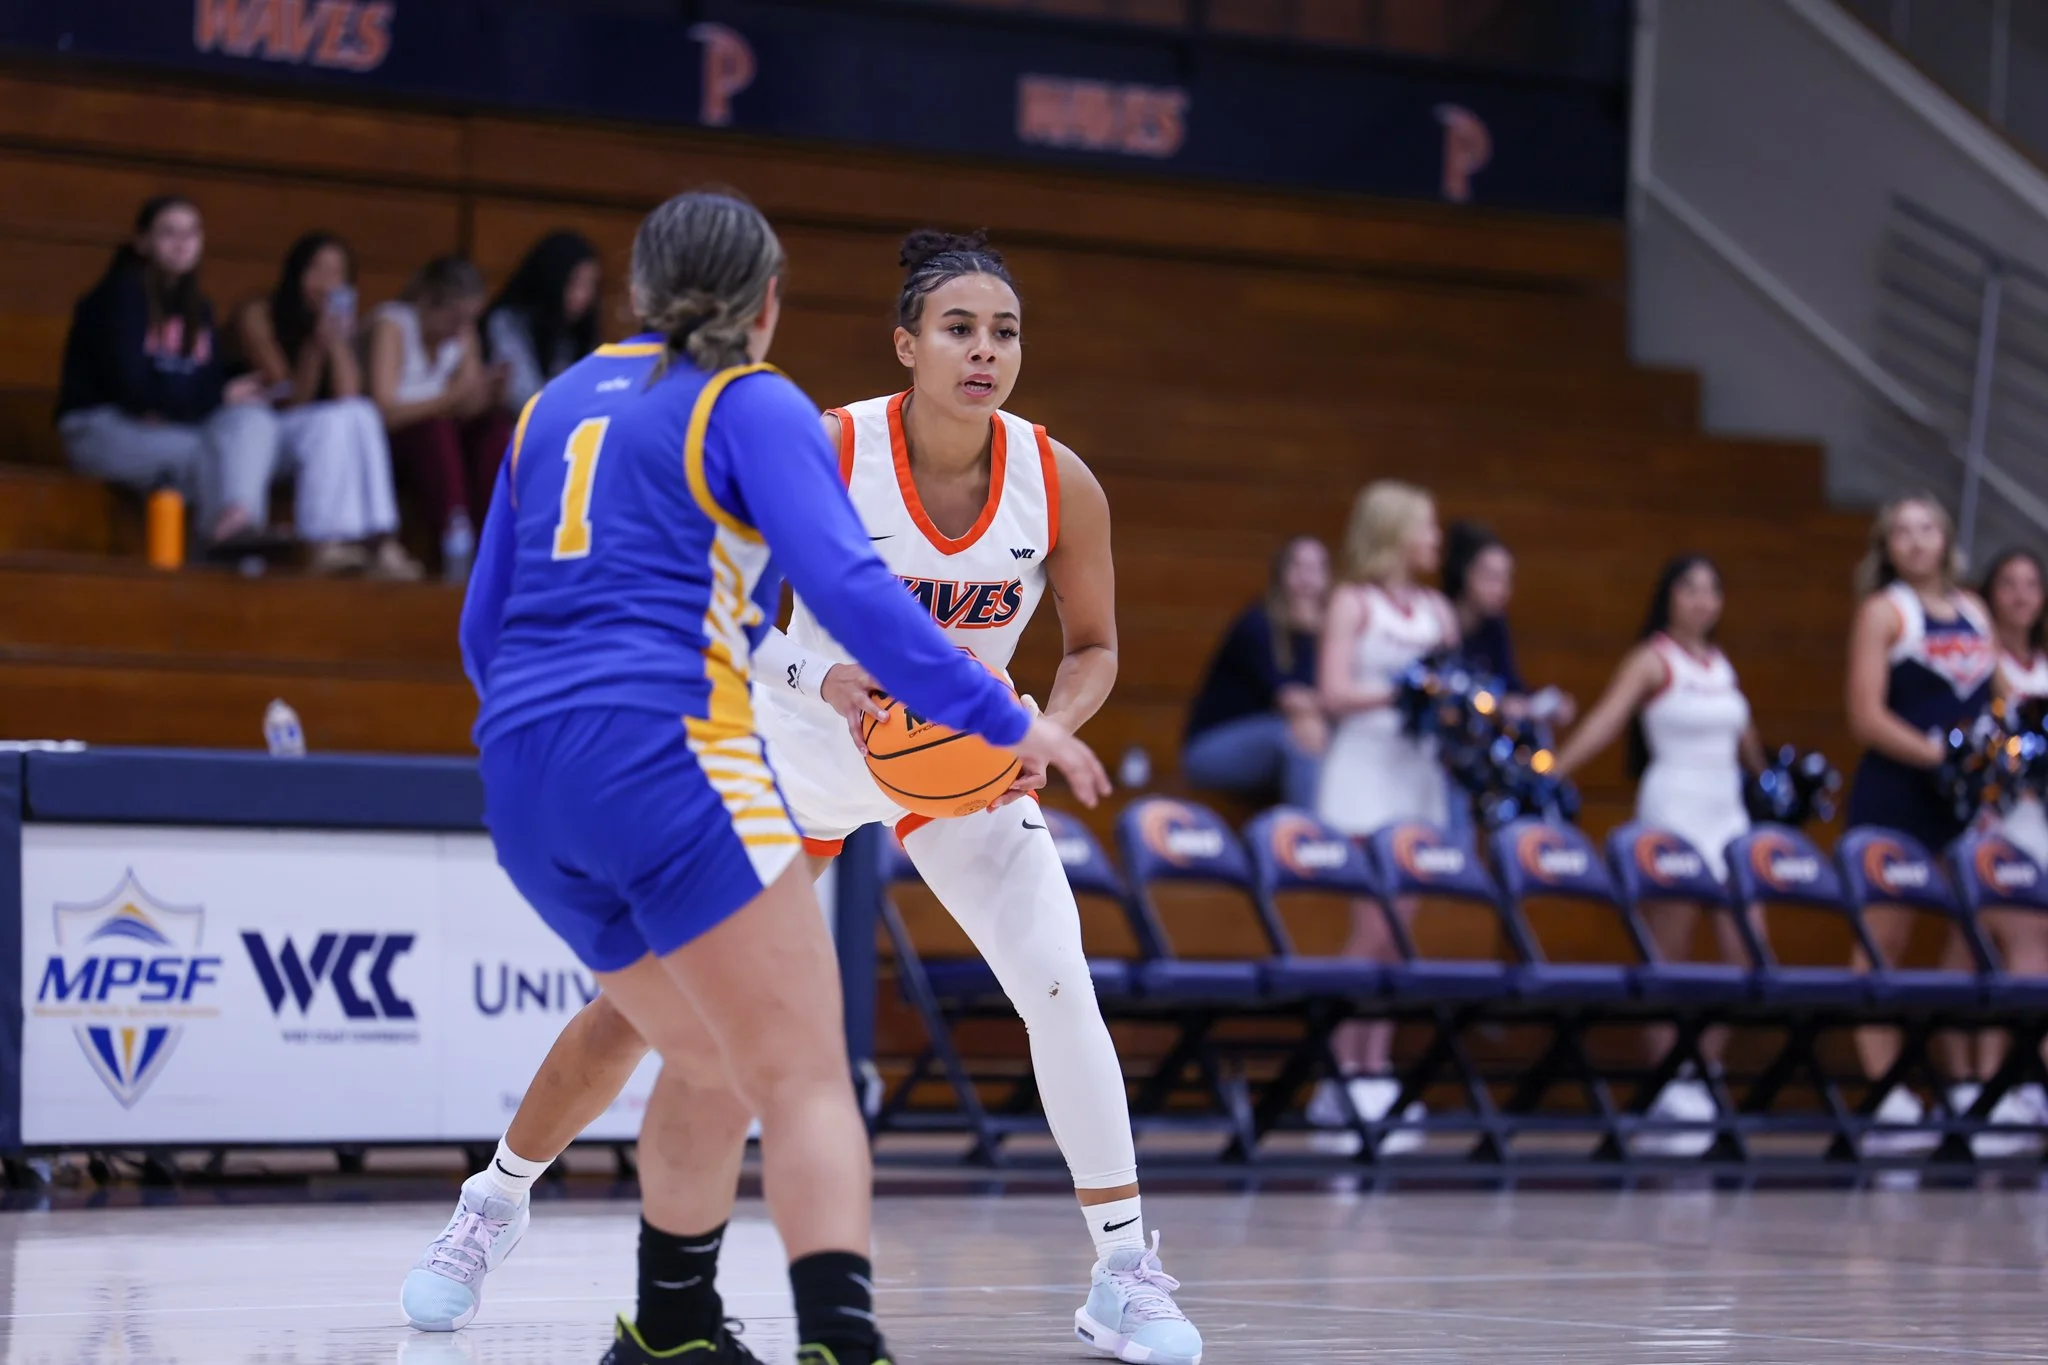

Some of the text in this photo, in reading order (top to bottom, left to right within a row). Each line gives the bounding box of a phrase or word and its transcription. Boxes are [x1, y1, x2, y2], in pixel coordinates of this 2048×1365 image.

[193, 0, 394, 71] WAVES
[687, 23, 757, 127] P
[552, 416, 611, 560] 1
[893, 576, 1024, 629] AVES
[37, 956, 223, 1003] MPSF
[239, 932, 417, 1019] WCC
